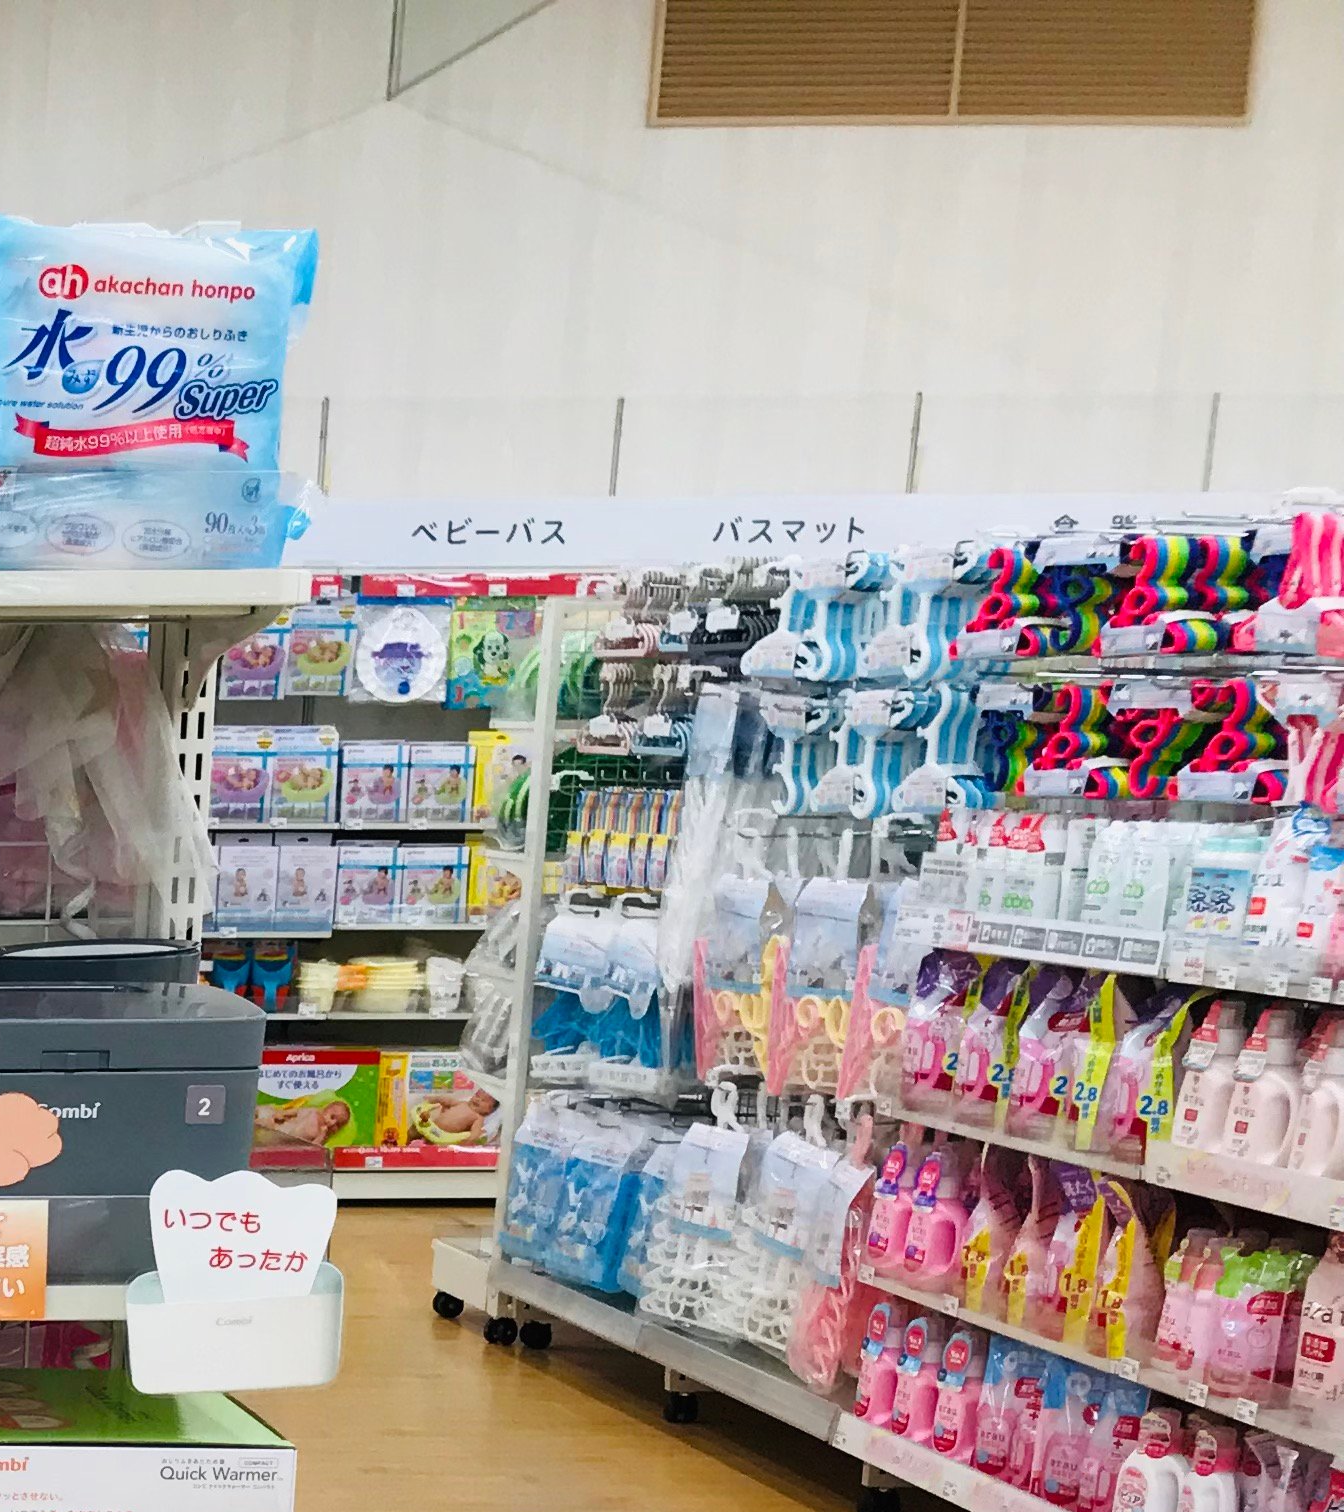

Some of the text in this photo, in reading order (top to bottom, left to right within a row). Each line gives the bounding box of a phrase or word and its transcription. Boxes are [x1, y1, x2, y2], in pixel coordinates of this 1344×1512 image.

[94, 278, 183, 296] akachan
[192, 281, 255, 303] honpo
[176, 379, 278, 420] Super
[413, 519, 566, 545] ベビーバス
[713, 516, 865, 544] バスマット
[198, 1098, 211, 1116] 2
[164, 1209, 261, 1234] いつでも
[209, 1248, 309, 1273] あったか
